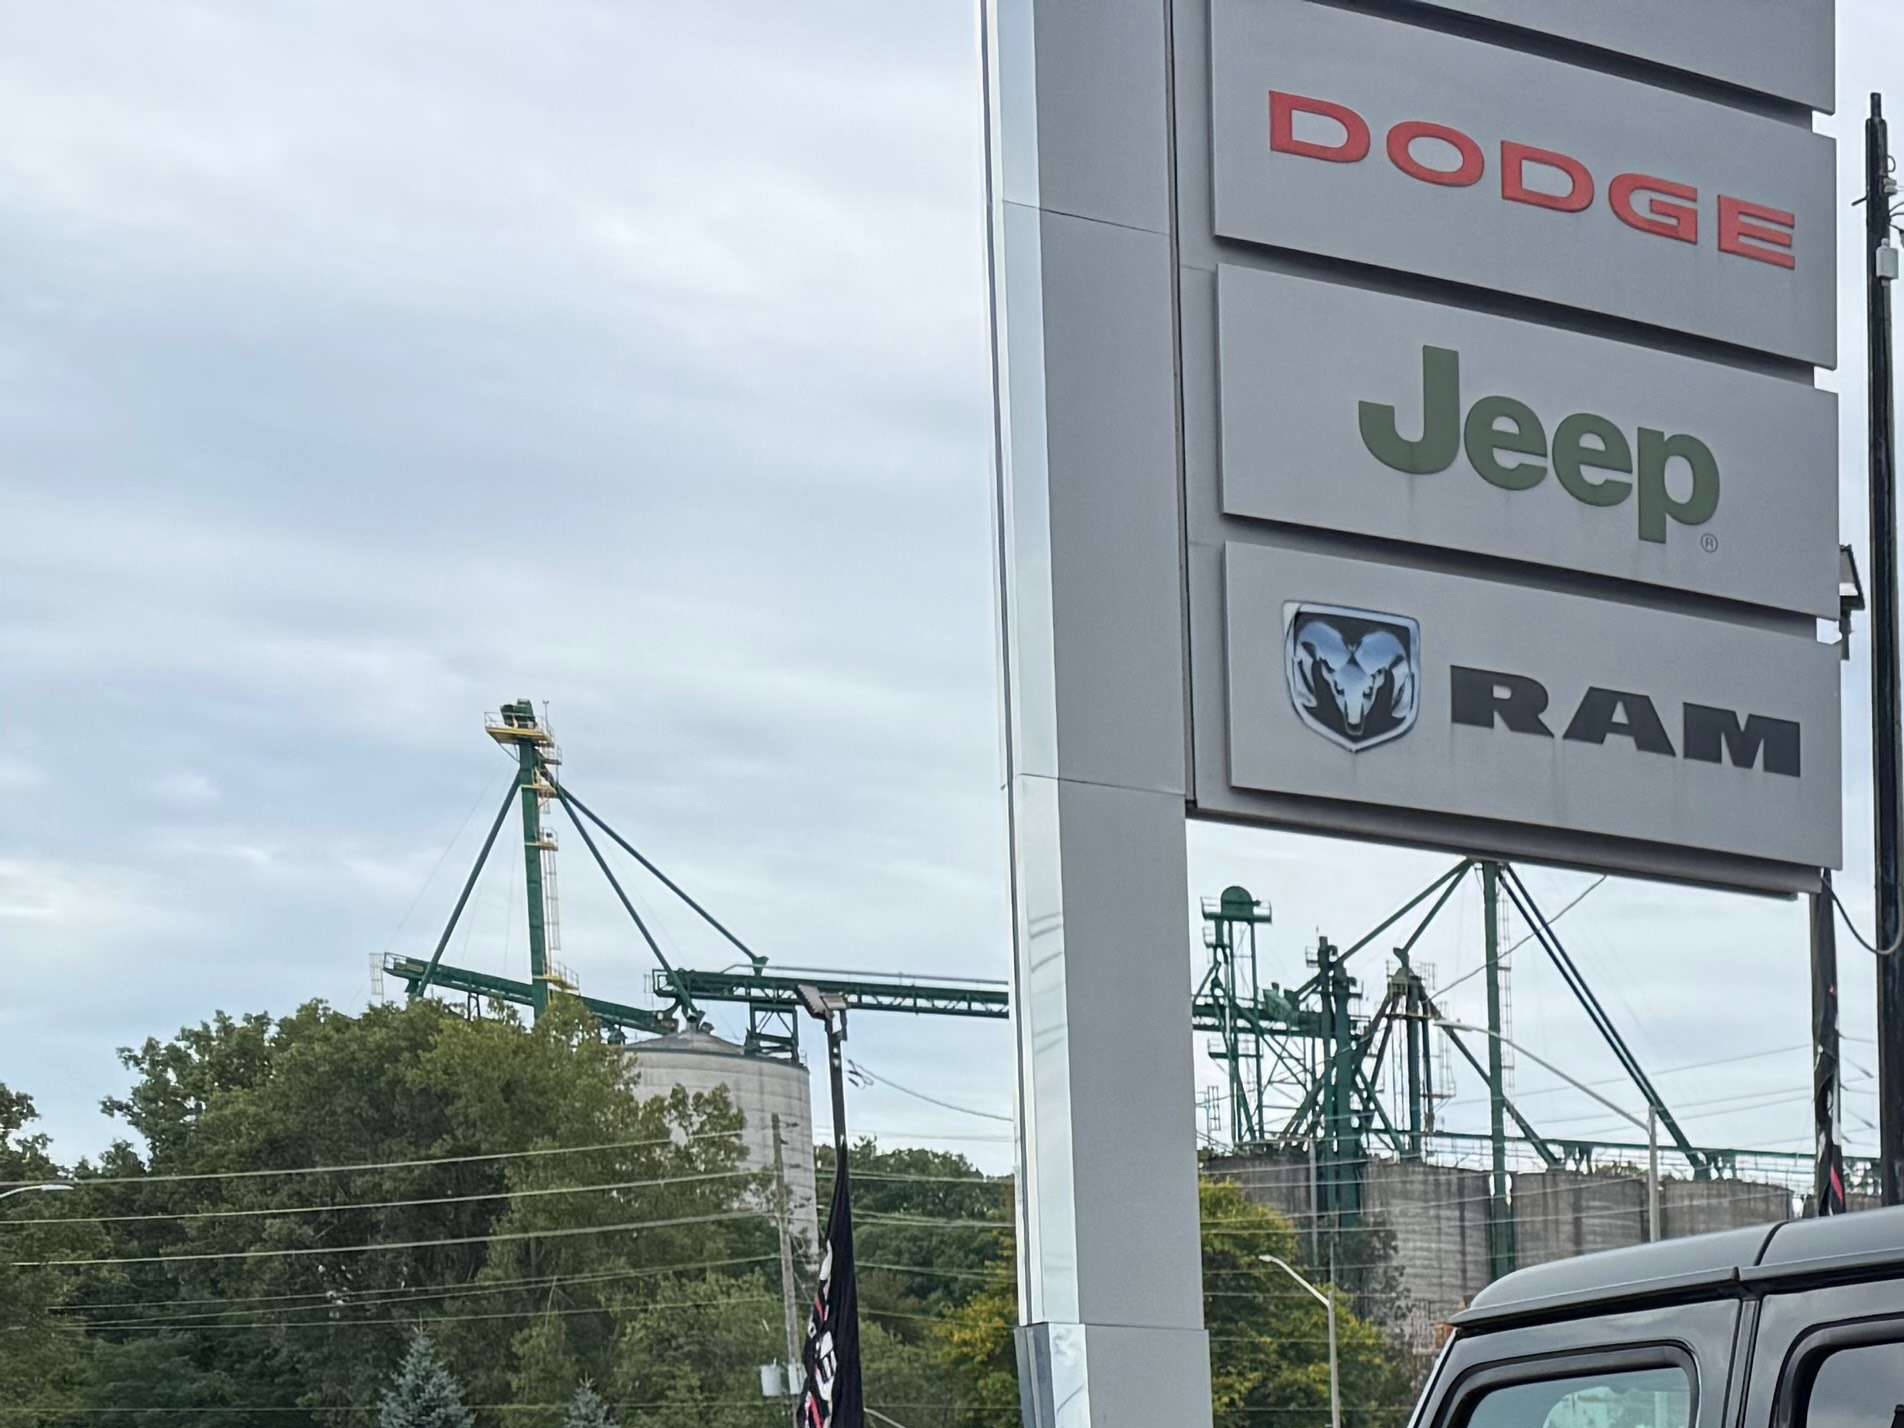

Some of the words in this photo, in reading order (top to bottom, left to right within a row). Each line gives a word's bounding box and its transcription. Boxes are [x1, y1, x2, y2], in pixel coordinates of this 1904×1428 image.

[1268, 90, 1796, 270] DODGE
[1359, 344, 1720, 543] Jeep
[1450, 664, 1801, 777] RAM
